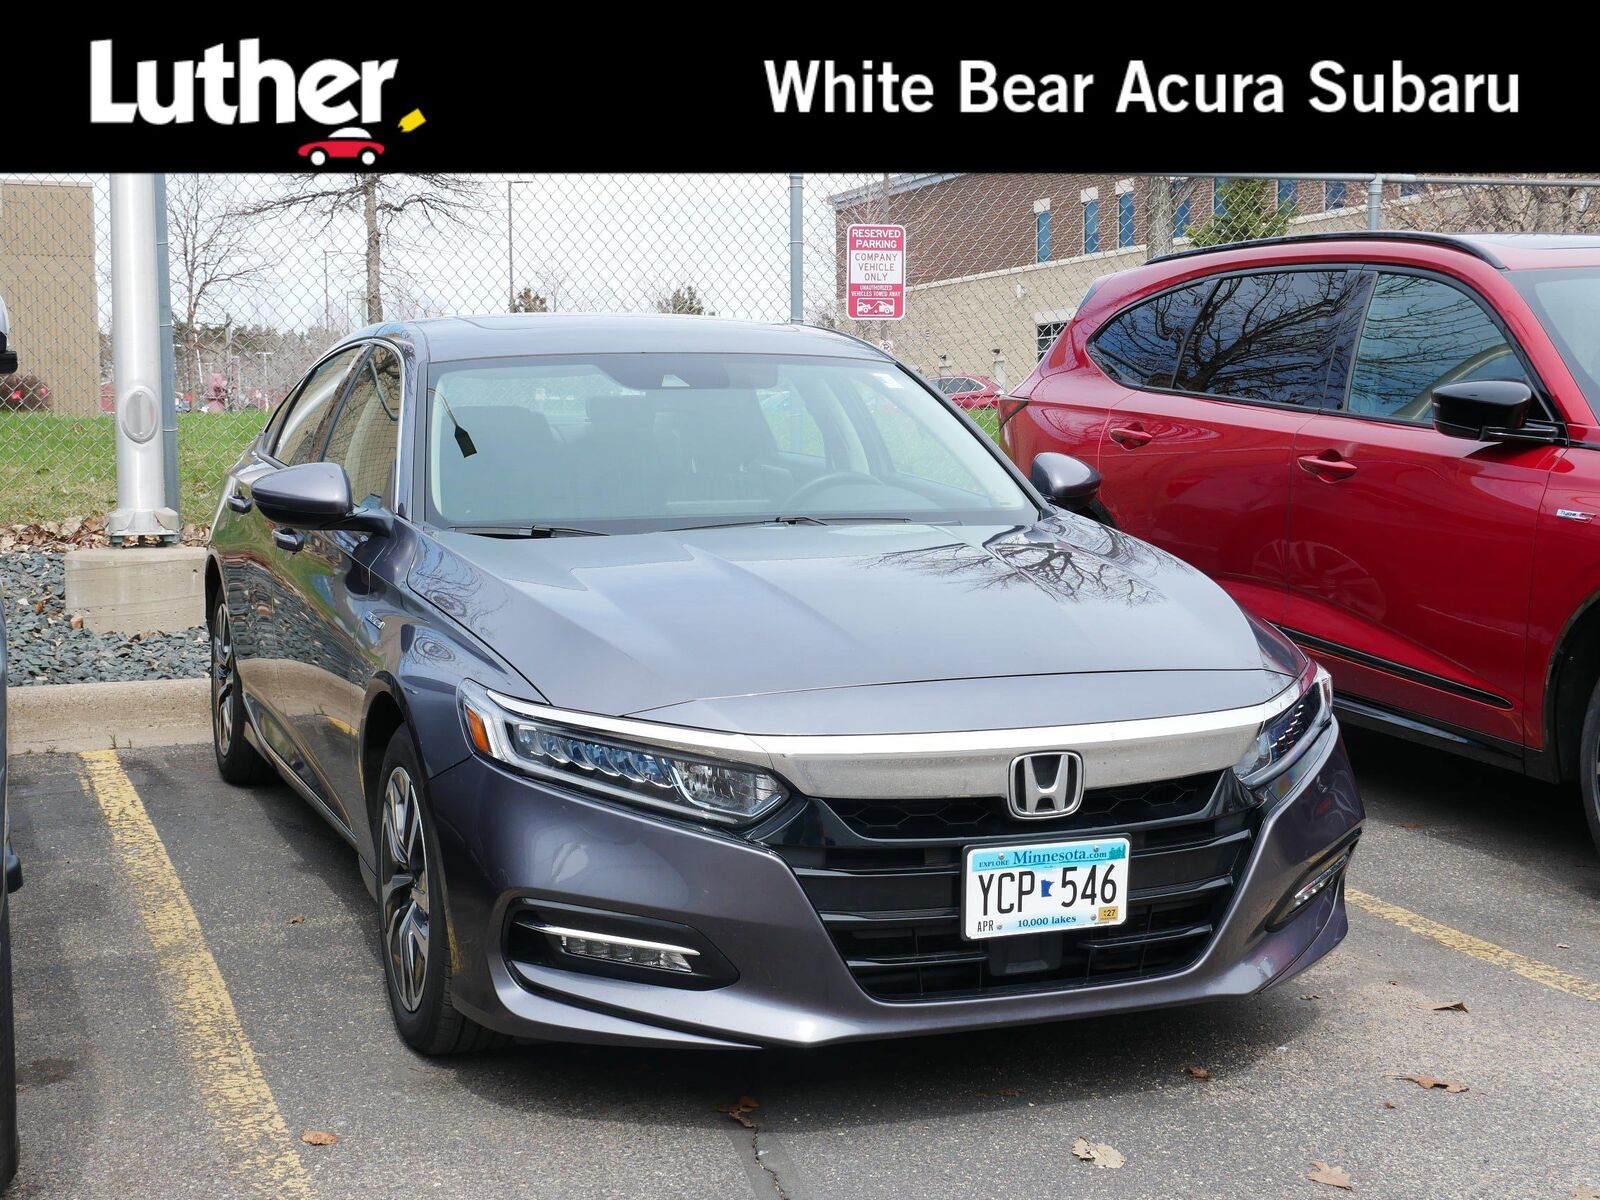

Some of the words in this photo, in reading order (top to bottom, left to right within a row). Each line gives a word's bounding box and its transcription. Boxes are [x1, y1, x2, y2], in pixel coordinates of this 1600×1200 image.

[852, 229, 901, 238] RESERVED
[856, 240, 897, 248] PARKING
[854, 253, 898, 261] COMPANY
[858, 263, 895, 271] VEHICLE
[864, 273, 888, 281] ONLY
[979, 859, 1010, 868] EXPLORE
[978, 871, 1035, 916] YCP
[1061, 864, 1117, 908] 546
[1106, 908, 1116, 917] 27
[977, 919, 994, 933] APR
[1018, 918, 1050, 928] 10,000
[1051, 915, 1077, 924] lakes
